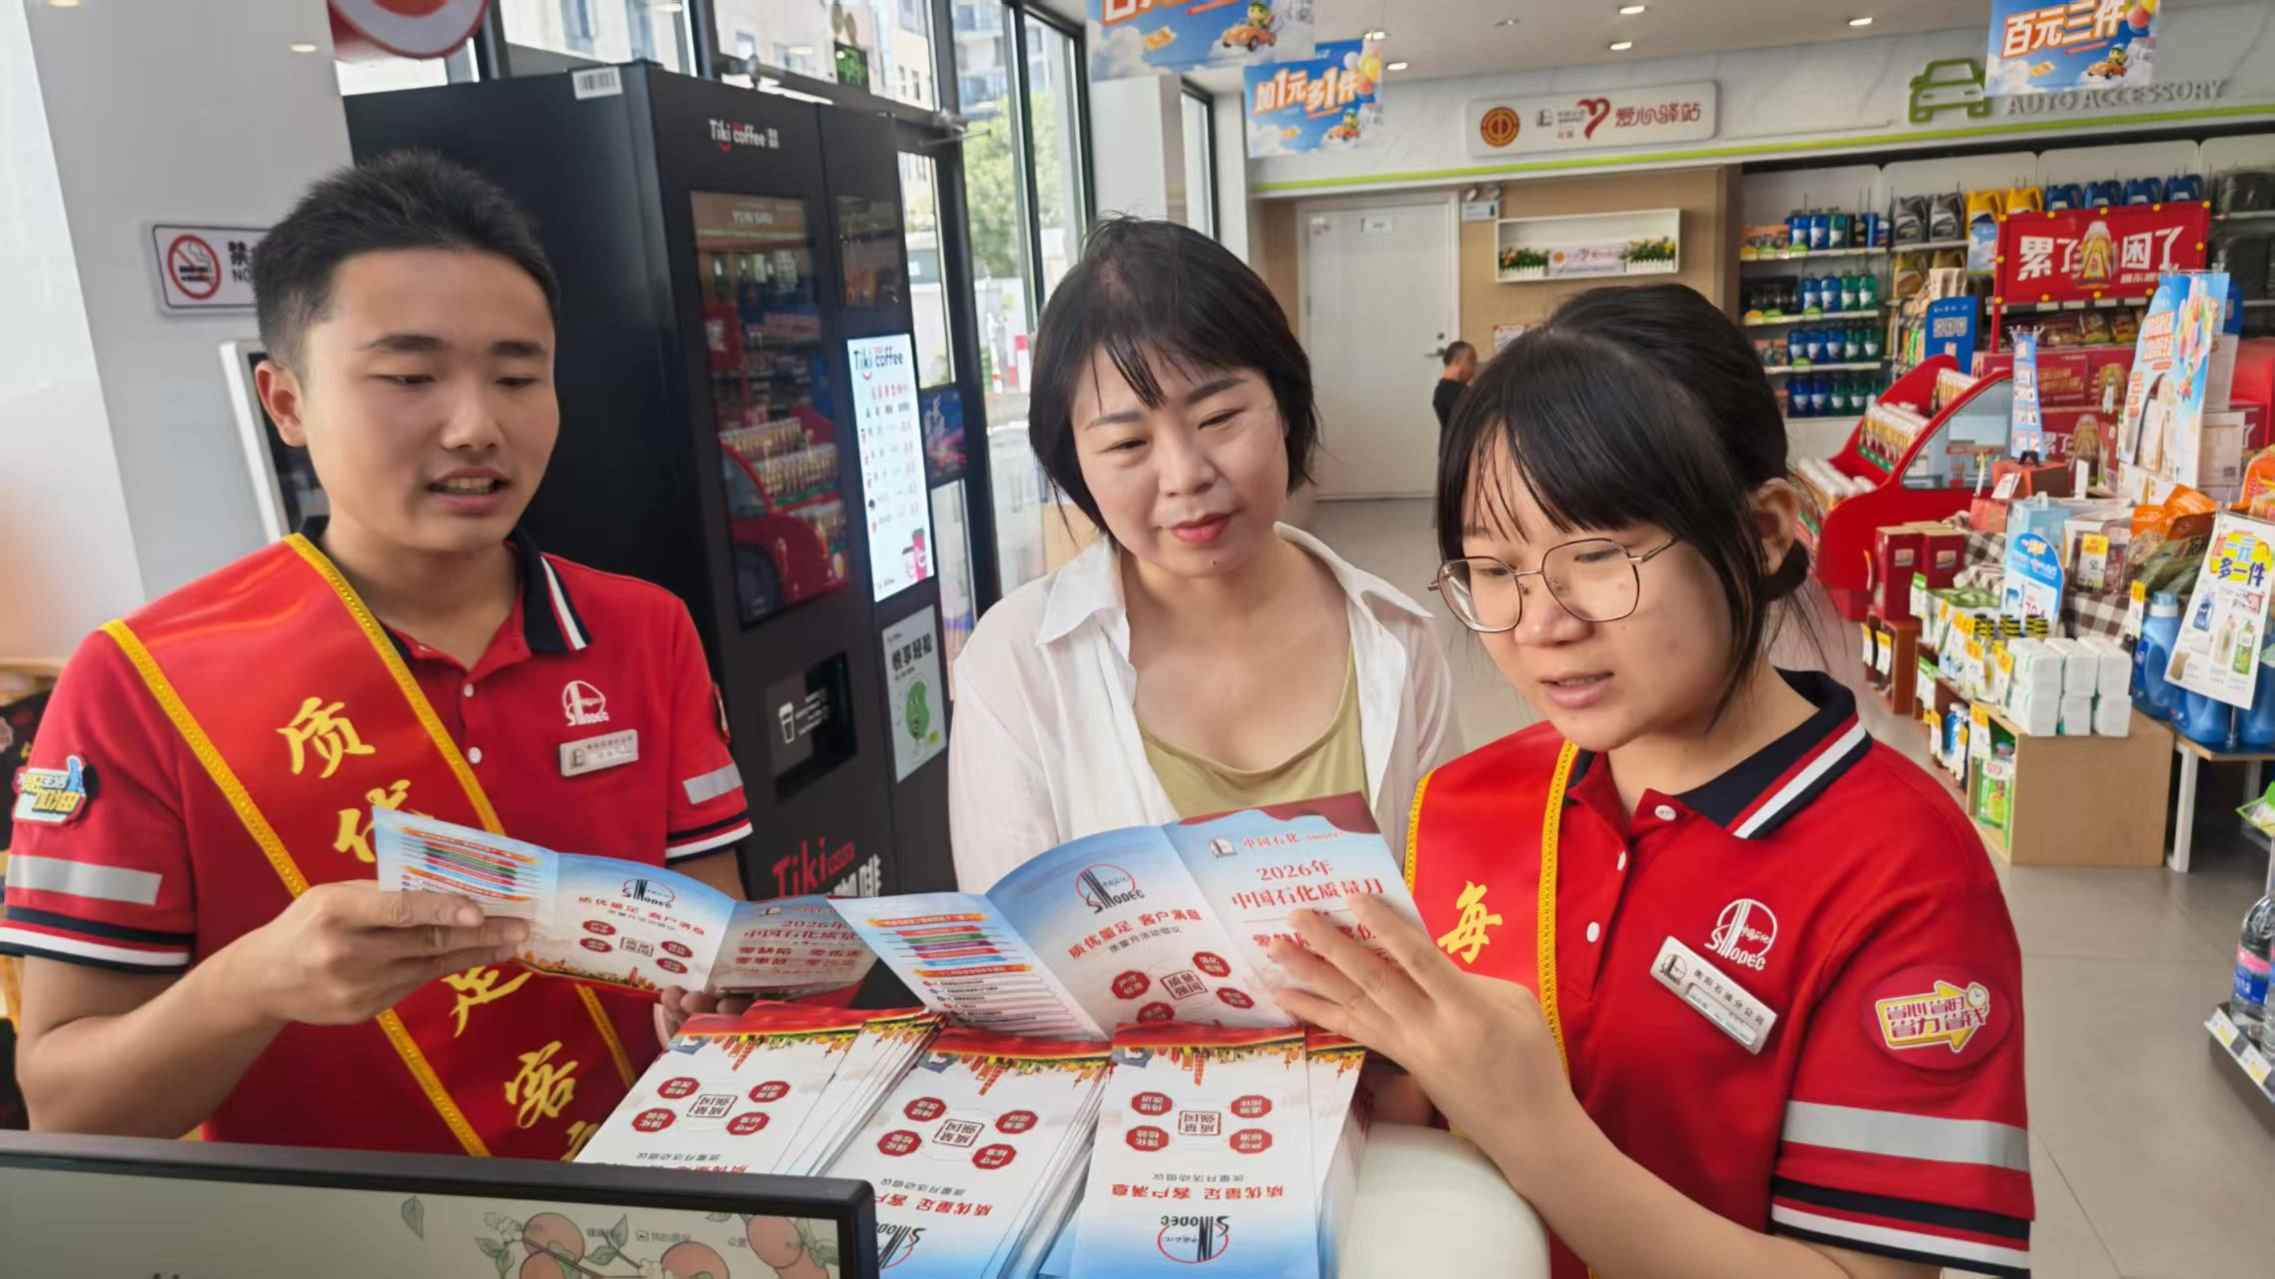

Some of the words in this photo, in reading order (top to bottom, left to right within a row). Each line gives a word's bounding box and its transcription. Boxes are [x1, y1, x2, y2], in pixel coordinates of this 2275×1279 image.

[2002, 0, 2125, 58] 百元三件
[2017, 236, 2079, 281] 累了
[2121, 226, 2184, 272] 困了
[2217, 557, 2265, 588] 多一件
[1256, 859, 1333, 881] 2026年
[1232, 878, 1384, 909] 中国石化质量月
[1068, 919, 1132, 959] 质优量足
[1138, 908, 1202, 927] 客户满意
[1437, 880, 1503, 964] 每
[916, 1198, 993, 1216] 质优量足
[1112, 1184, 1190, 1200] 客户满意
[1203, 1184, 1283, 1200] 质优量足
